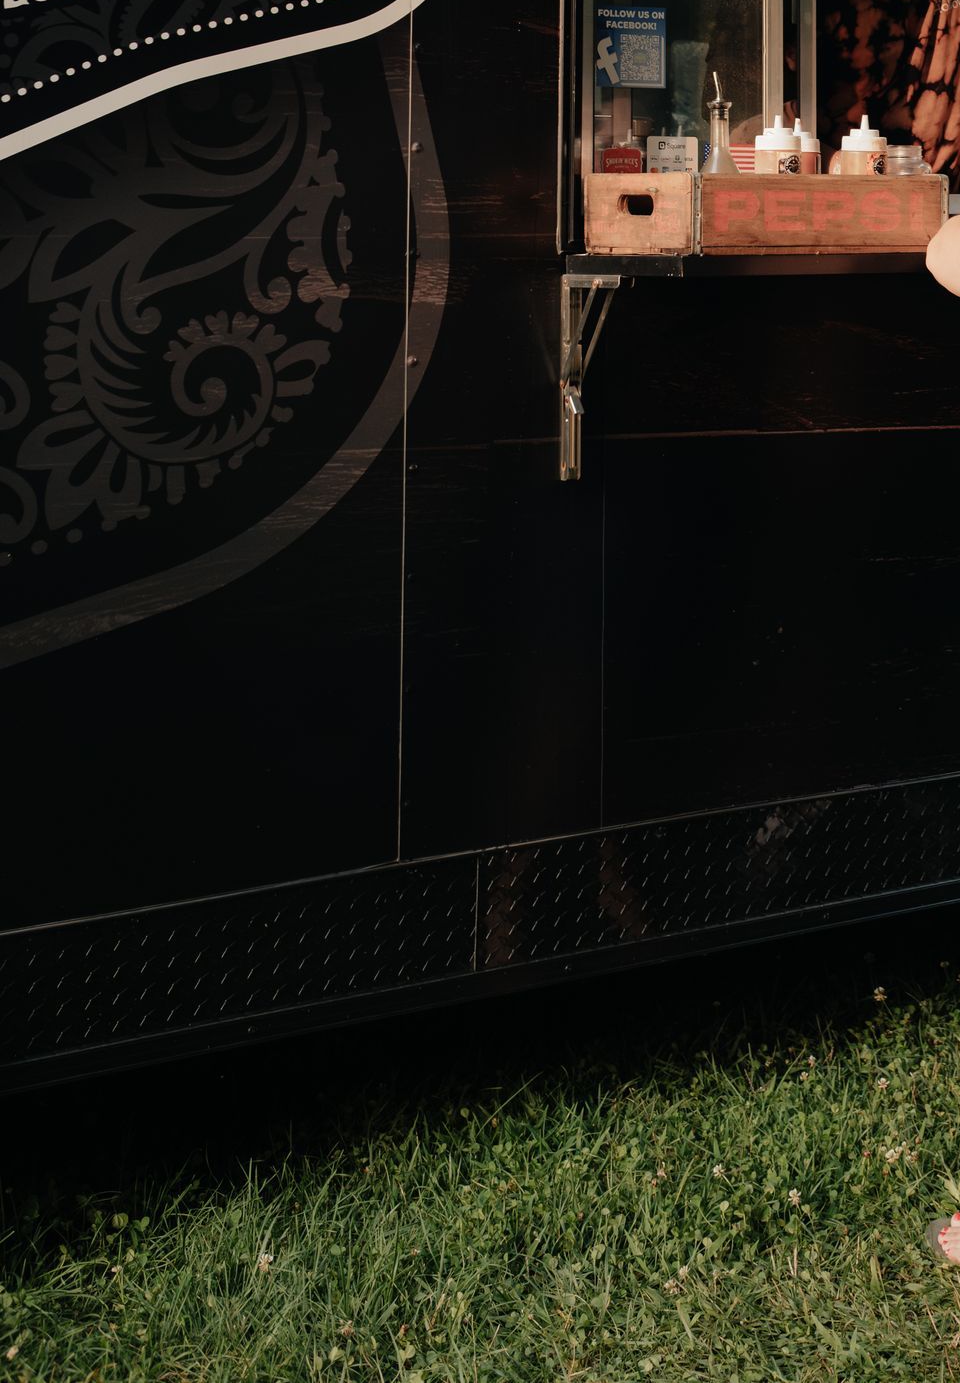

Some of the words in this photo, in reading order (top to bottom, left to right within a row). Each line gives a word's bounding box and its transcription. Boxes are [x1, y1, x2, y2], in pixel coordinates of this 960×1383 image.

[597, 8, 635, 18] FOLLOW
[637, 11, 650, 19] US
[651, 11, 665, 20] ON
[605, 20, 657, 30] FACEBOOK!
[666, 142, 686, 150] Square
[713, 189, 924, 232] PEPSI
